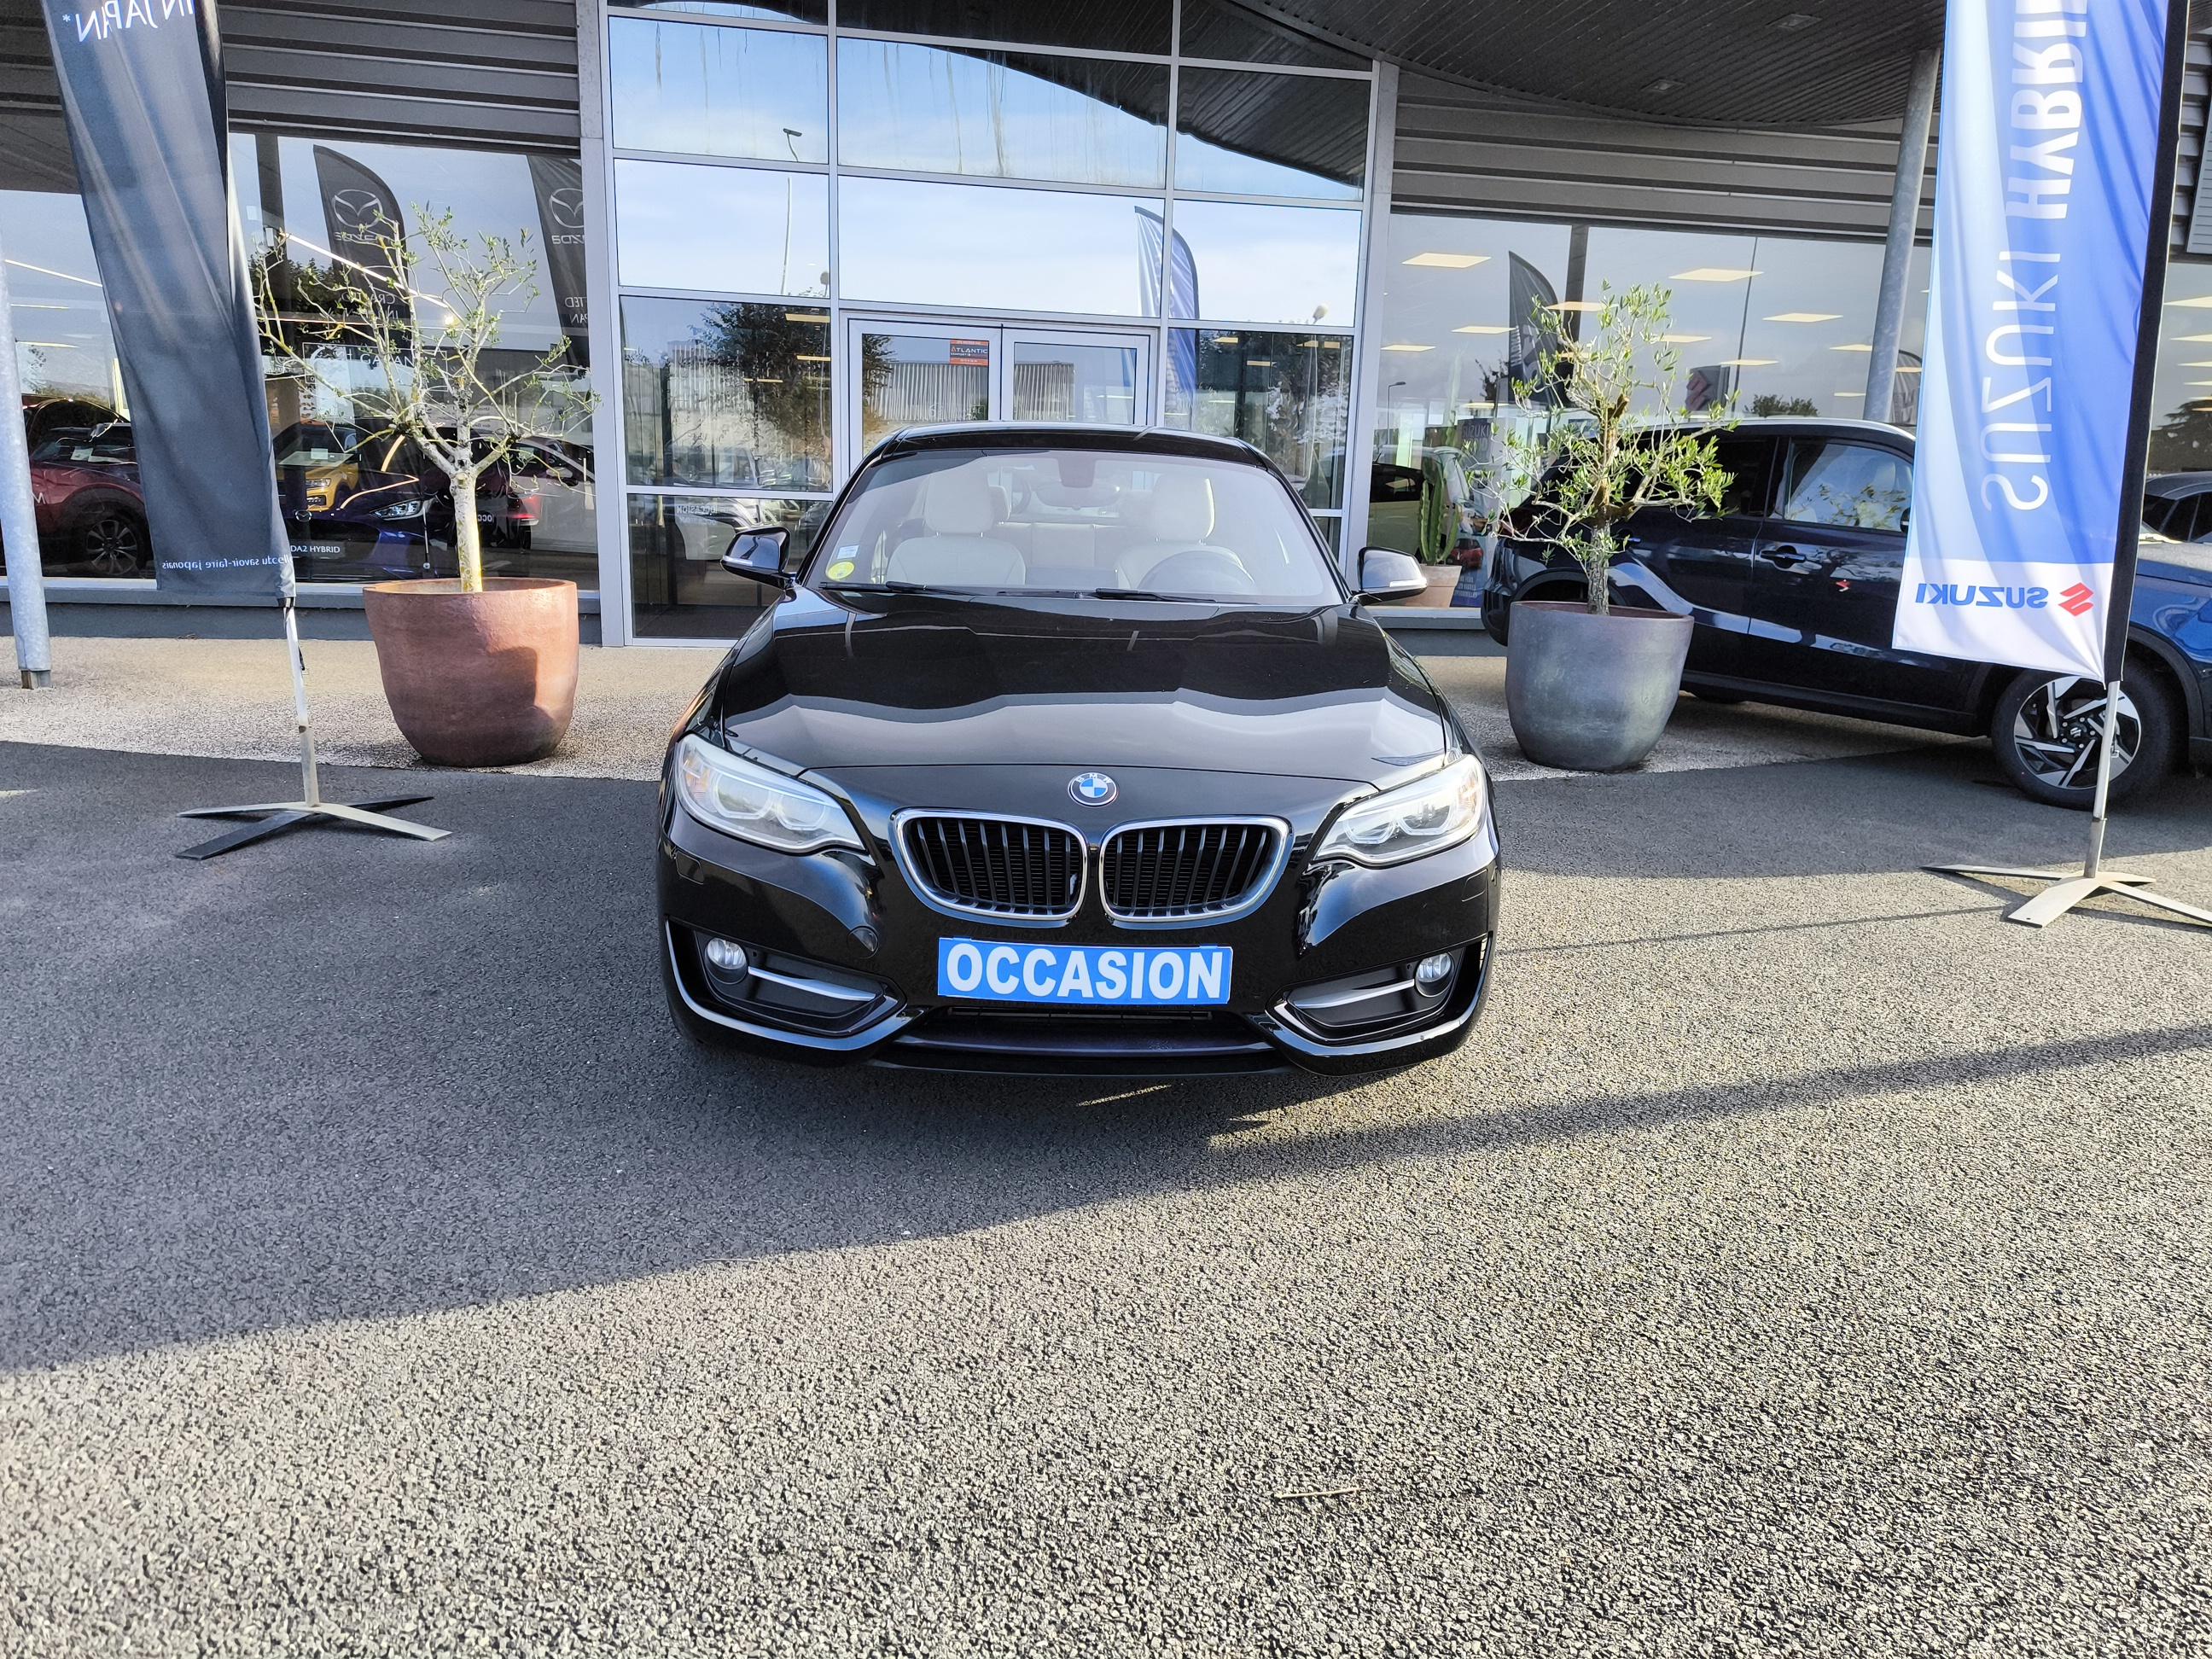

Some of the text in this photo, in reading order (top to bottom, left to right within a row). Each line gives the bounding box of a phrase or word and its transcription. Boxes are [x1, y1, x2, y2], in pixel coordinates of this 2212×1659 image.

[951, 346, 988, 354] ATLANTIC
[290, 544, 341, 554] DA2 HYBRID
[1074, 772, 1112, 783] BMW
[946, 943, 1224, 1000] OCCASION
